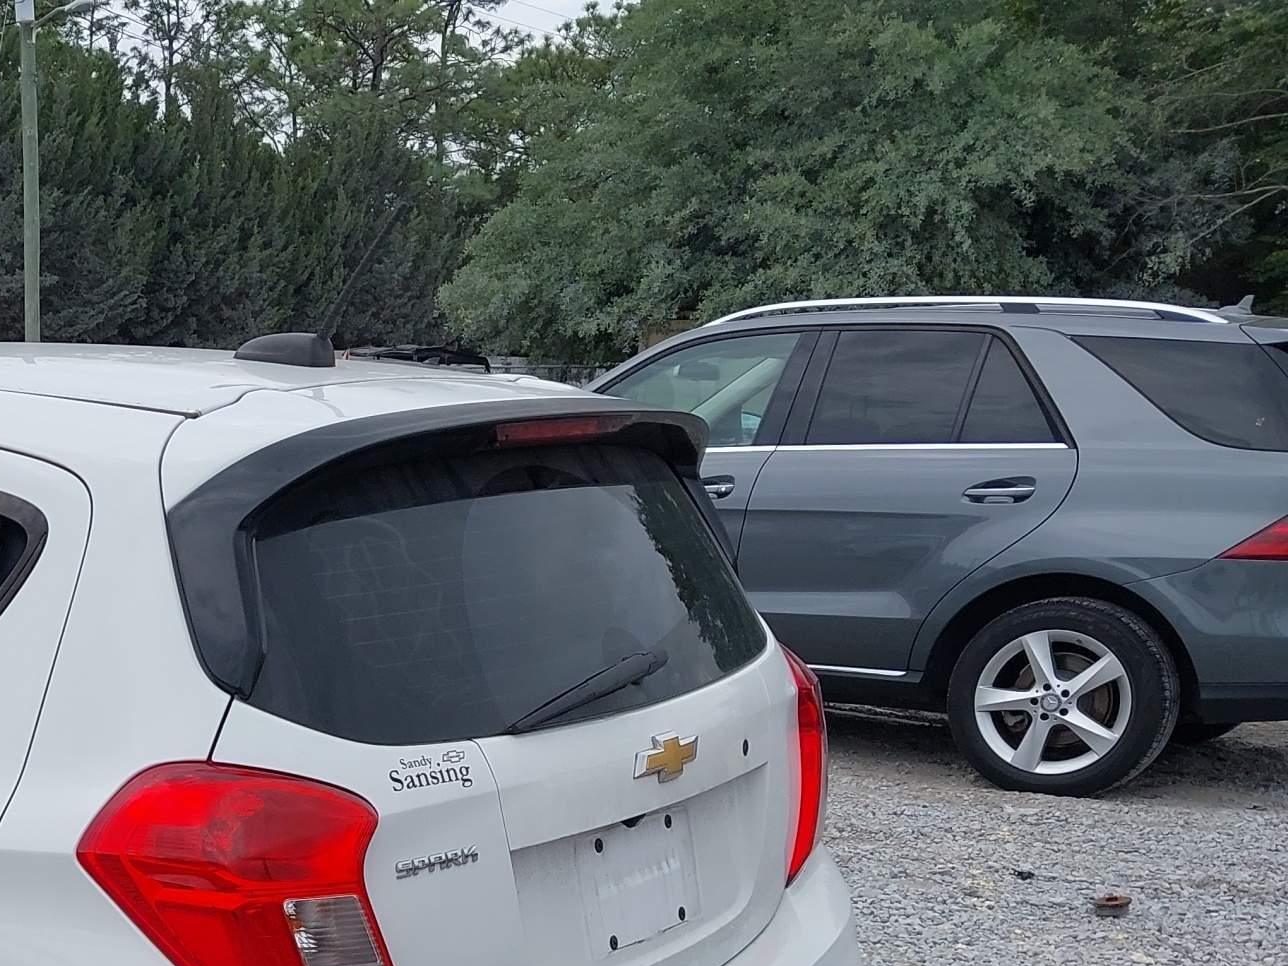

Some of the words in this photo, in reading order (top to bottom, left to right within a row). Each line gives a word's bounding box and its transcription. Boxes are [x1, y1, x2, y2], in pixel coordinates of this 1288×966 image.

[389, 762, 473, 792] Sansing
[399, 755, 432, 770] Sandy
[395, 844, 479, 878] SPARK
